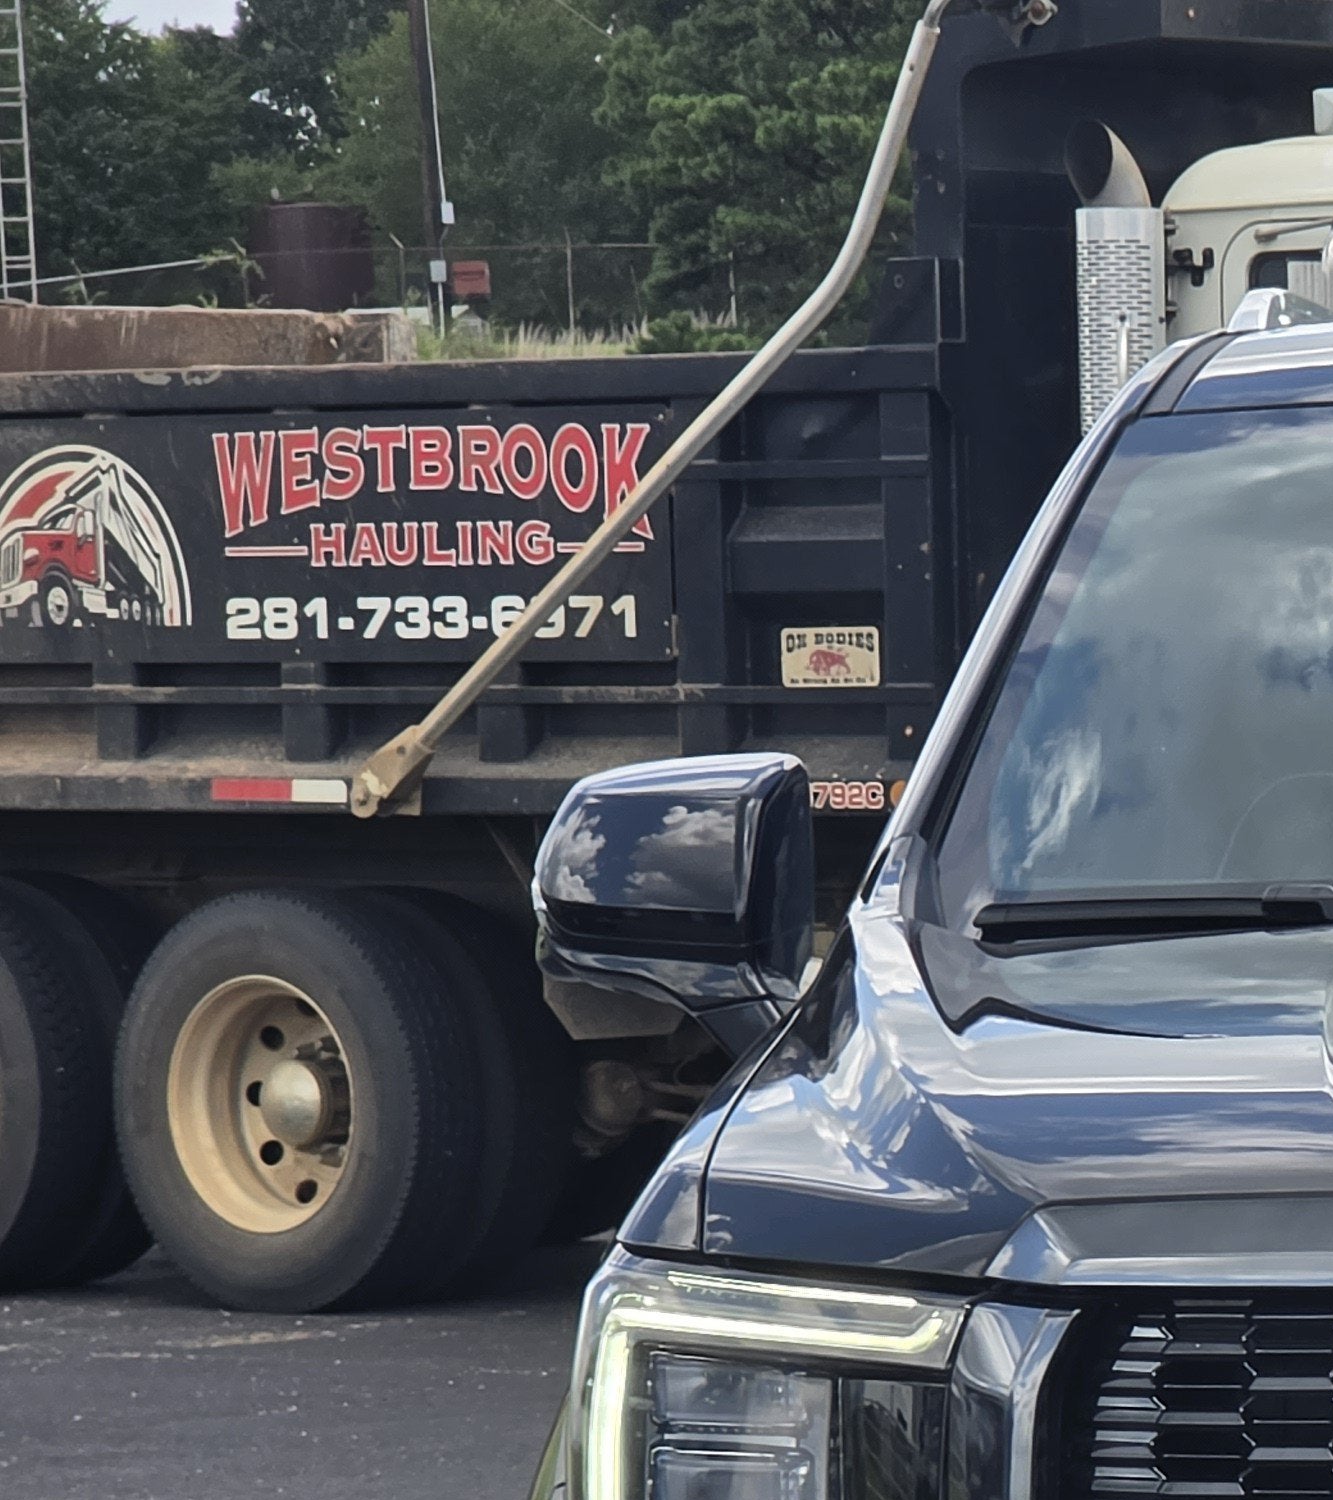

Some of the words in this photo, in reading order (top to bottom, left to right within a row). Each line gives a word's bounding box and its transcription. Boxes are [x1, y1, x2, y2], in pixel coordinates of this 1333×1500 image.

[212, 423, 654, 538] WESTBROOK
[310, 520, 555, 567] HAULING
[809, 781, 885, 809] 792C
